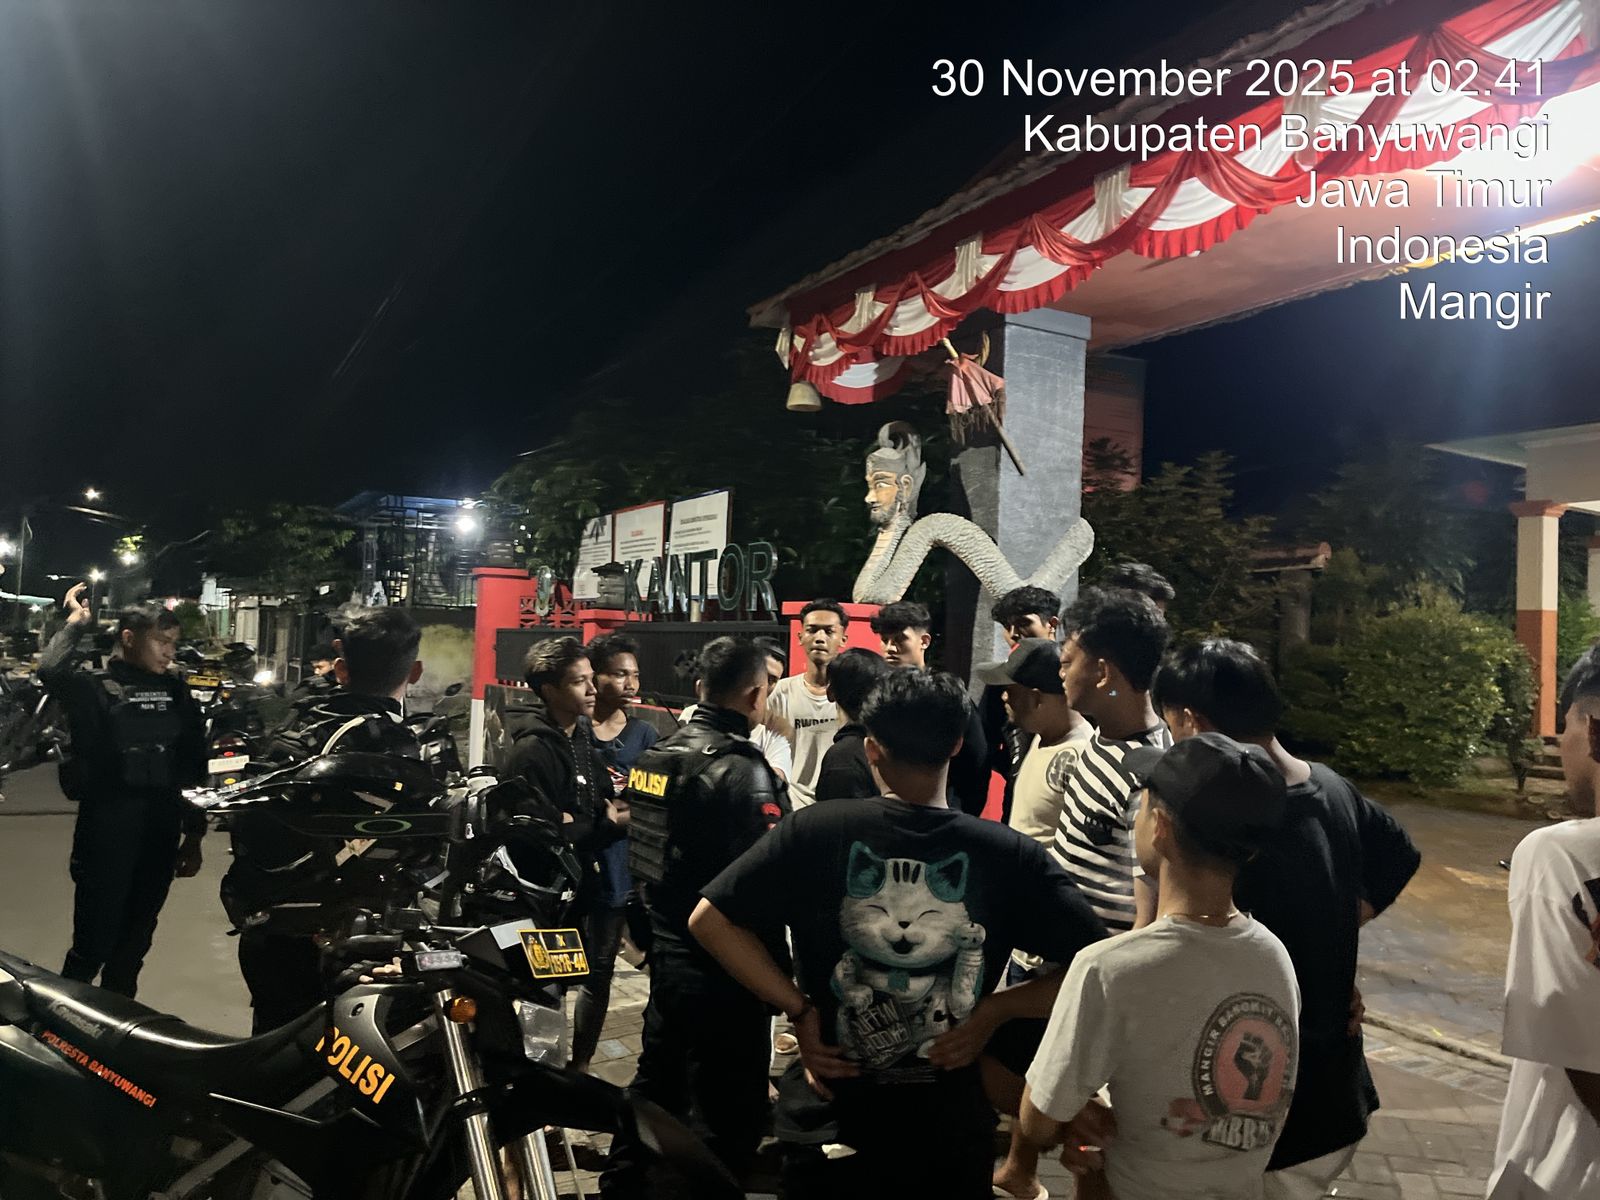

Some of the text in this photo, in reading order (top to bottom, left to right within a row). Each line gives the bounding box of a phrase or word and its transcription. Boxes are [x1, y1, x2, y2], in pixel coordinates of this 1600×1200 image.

[624, 541, 778, 614] KANTOR
[628, 767, 669, 797] POLISI
[41, 1029, 157, 1108] POLRESTA BANYUWANGI
[1199, 1028, 1220, 1096] MANGIR
